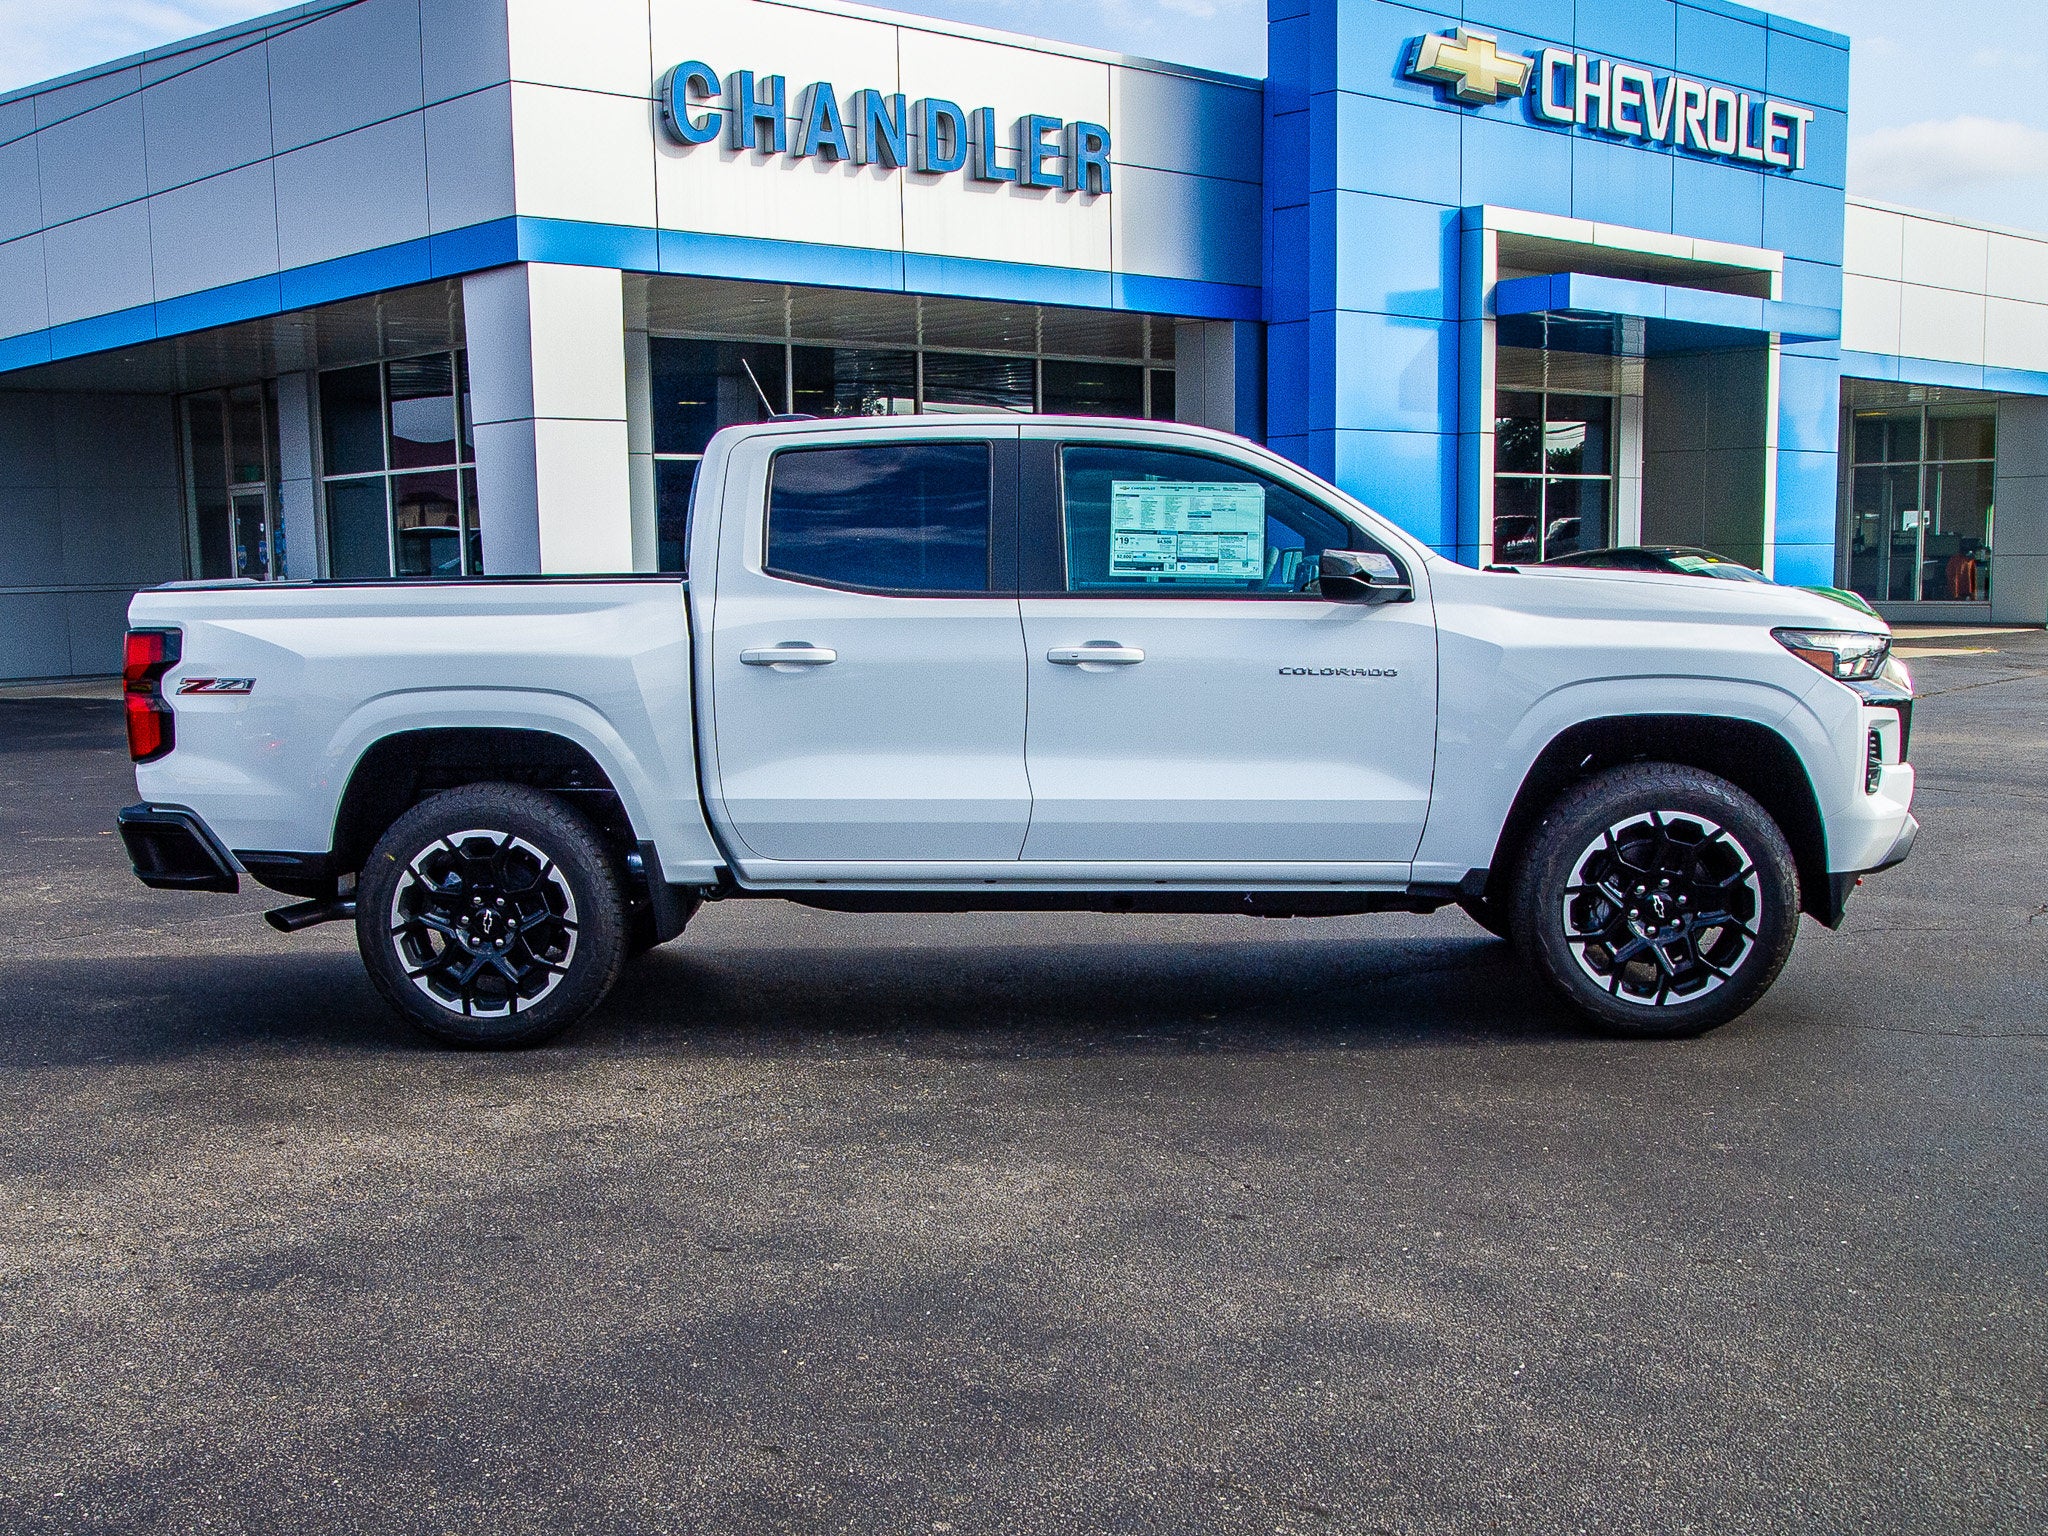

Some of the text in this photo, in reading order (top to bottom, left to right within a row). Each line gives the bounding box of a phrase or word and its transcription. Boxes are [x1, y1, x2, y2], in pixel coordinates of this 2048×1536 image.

[1536, 48, 1815, 170] CHEVROLET
[664, 60, 1112, 194] CHANDLER
[1119, 537, 1130, 545] 19
[1278, 666, 1398, 678] COLORADO
[175, 677, 257, 696] Z71
